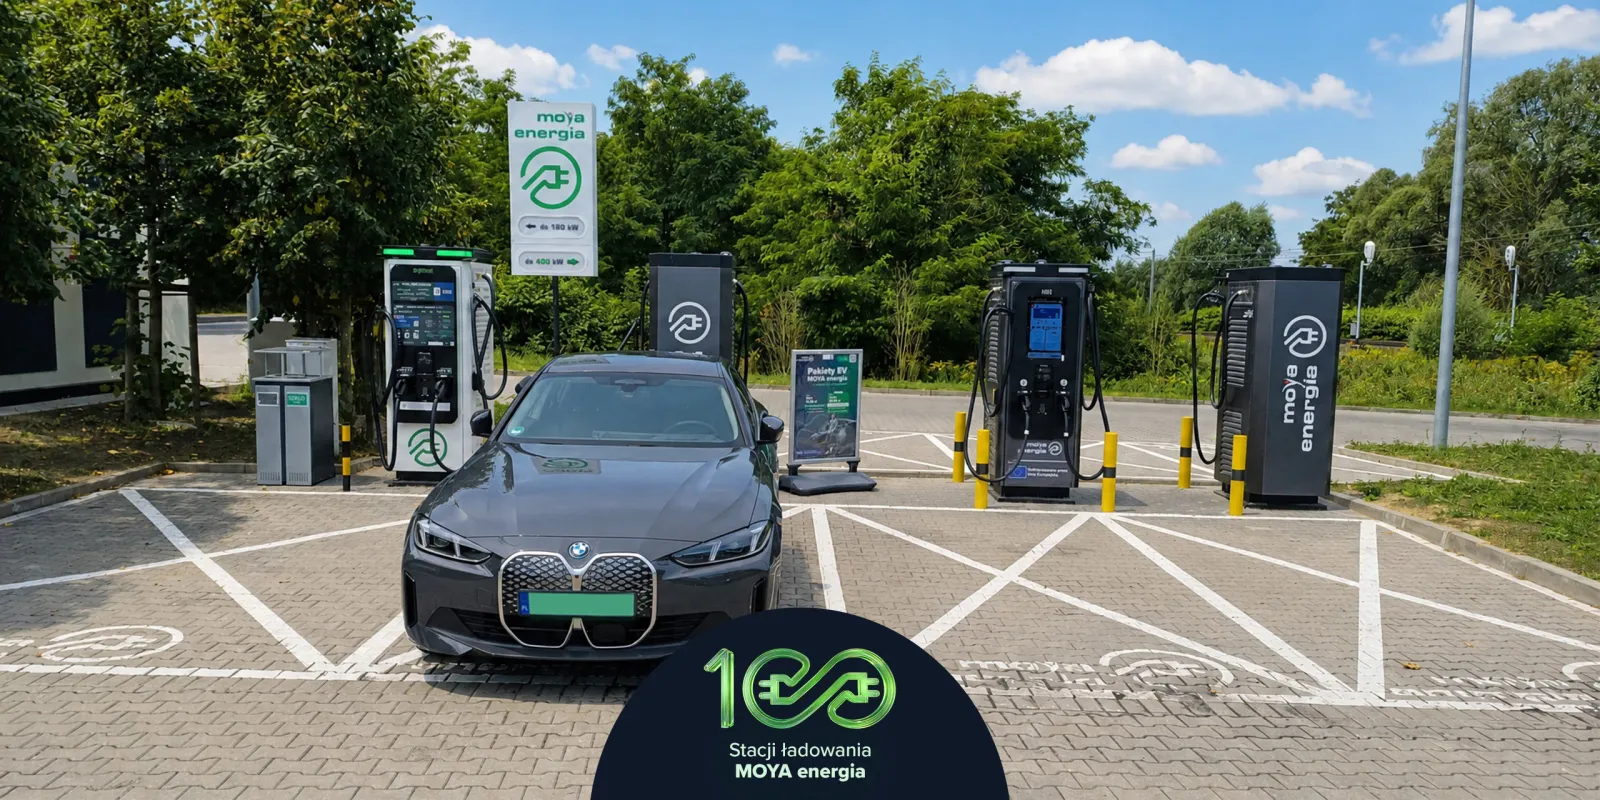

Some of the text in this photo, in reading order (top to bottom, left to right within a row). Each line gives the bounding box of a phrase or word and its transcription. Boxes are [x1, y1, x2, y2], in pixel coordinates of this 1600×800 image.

[537, 111, 585, 126] moya
[514, 127, 585, 141] energia
[808, 367, 835, 376] Pakiety
[1282, 364, 1306, 424] moya
[1301, 365, 1319, 452] energia
